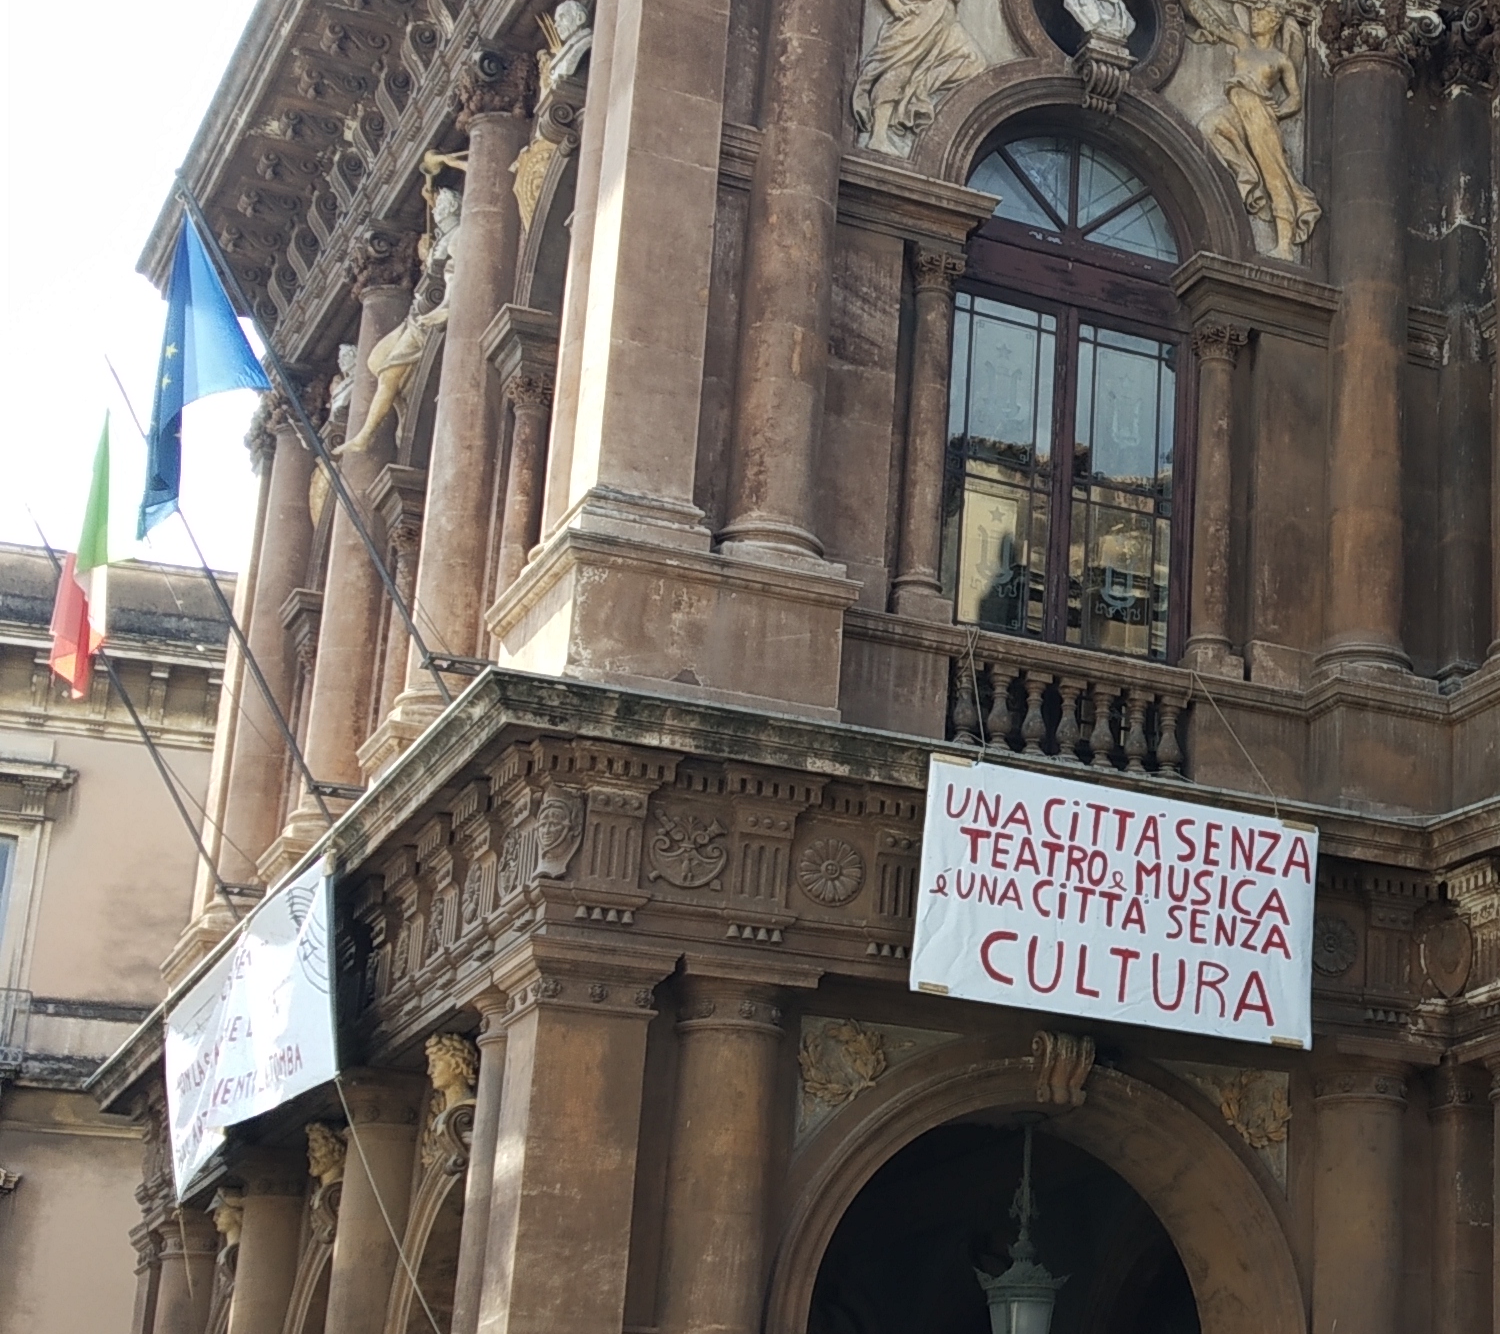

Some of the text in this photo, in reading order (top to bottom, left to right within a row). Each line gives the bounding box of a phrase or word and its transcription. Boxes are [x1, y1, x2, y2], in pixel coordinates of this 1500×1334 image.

[945, 783, 1033, 835] UNA
[1174, 818, 1311, 884] SENZA
[960, 826, 1109, 889] TEATRO
[1134, 859, 1290, 926] MUSICA
[955, 868, 1024, 911] UNA
[1165, 904, 1292, 960] SENZA
[979, 929, 1276, 1028] CULTURA
